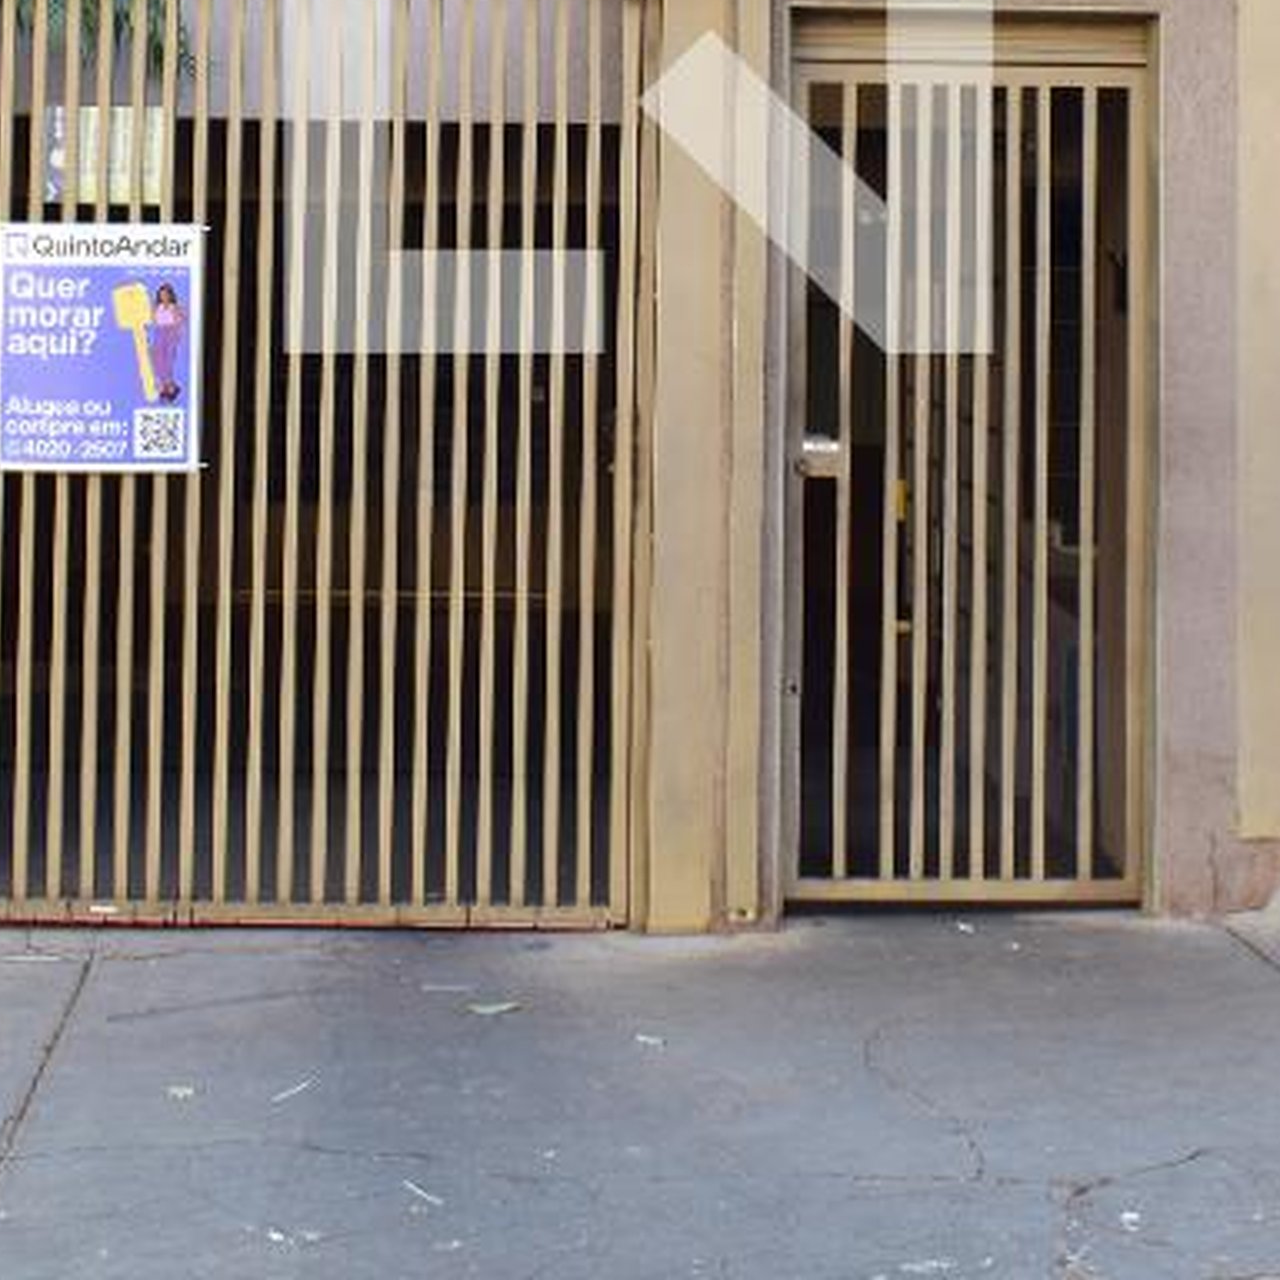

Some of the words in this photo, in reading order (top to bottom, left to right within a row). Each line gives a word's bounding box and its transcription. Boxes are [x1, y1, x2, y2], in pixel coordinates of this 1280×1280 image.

[32, 234, 192, 259] QuintoAndar
[10, 271, 90, 298] Quer
[7, 305, 105, 327] morar
[6, 329, 97, 359] aqui?
[4, 395, 79, 417] Alugue
[82, 399, 111, 417] ou
[3, 419, 84, 437] compre
